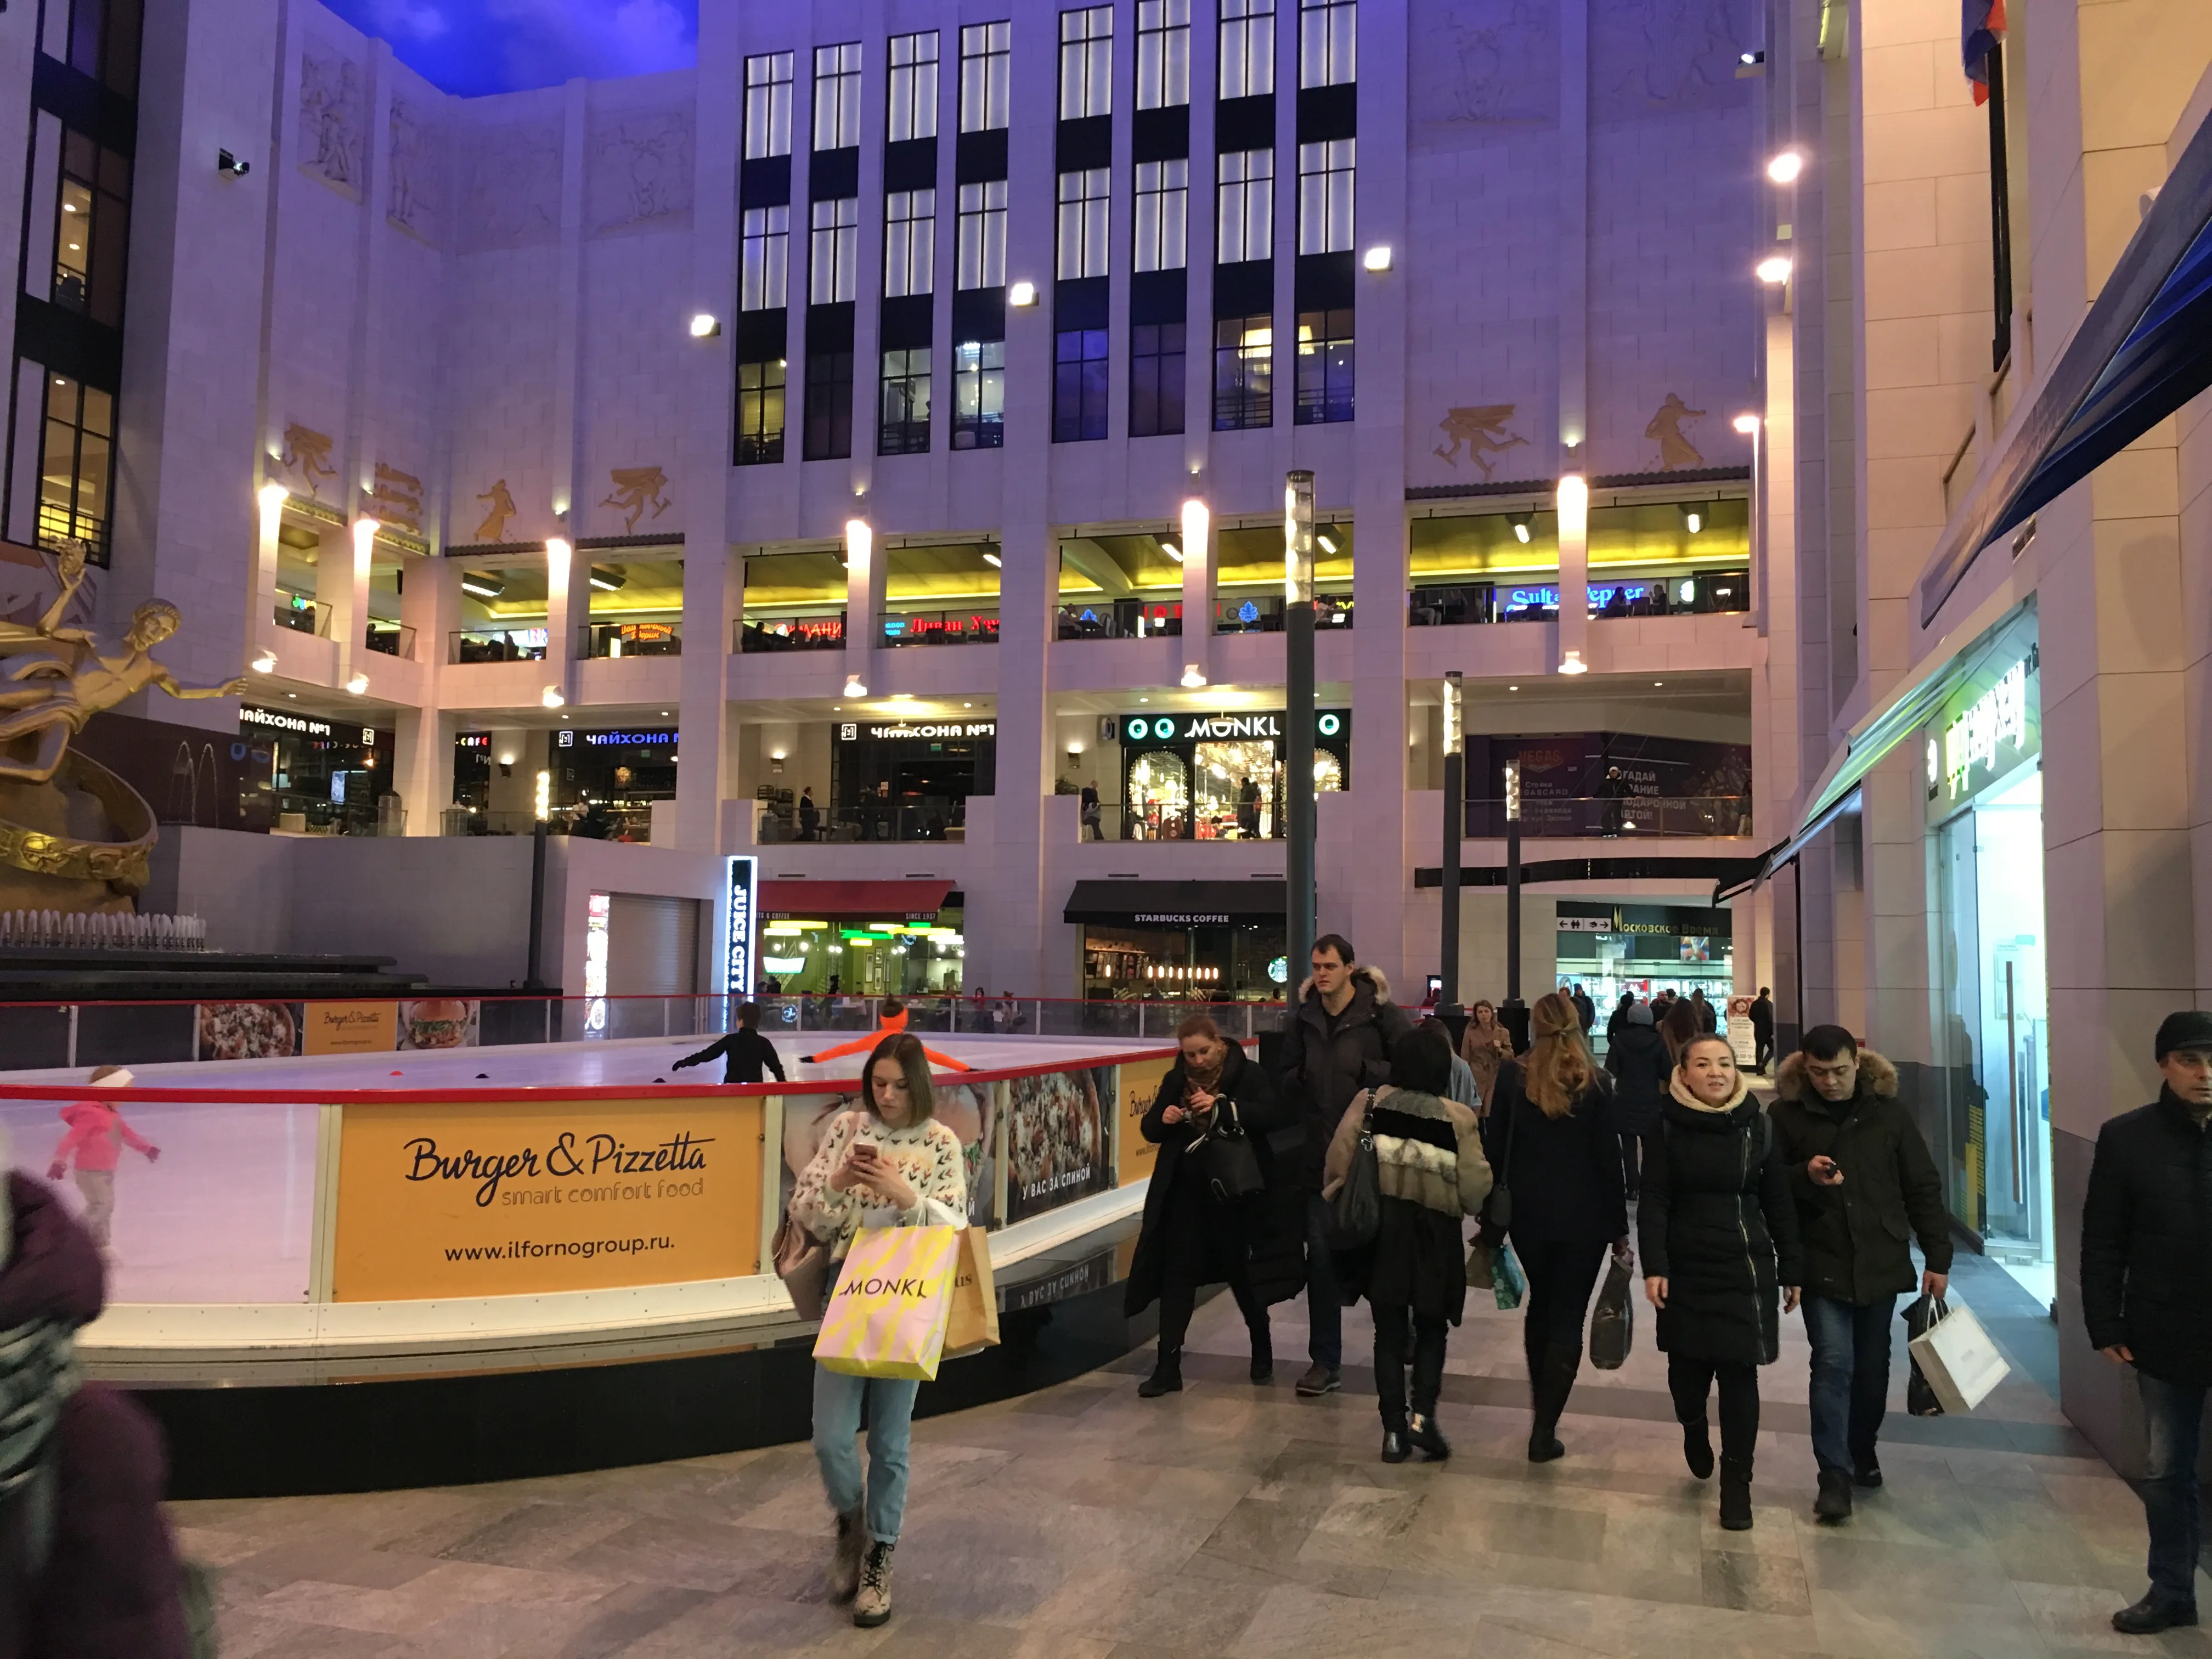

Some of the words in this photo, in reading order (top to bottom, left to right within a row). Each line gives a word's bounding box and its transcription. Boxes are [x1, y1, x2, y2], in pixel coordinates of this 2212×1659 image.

[1512, 588, 1559, 605] Sulta
[586, 731, 669, 745] ЧАЙХОНА
[1184, 716, 1281, 738] MONKI
[732, 884, 747, 943] JUICE
[1135, 914, 1191, 922] STARBUCKS
[1193, 915, 1229, 923] COFFEE
[730, 945, 746, 992] CITY
[403, 1137, 541, 1207] Burger
[546, 1132, 585, 1177] &
[586, 1131, 716, 1175] Pizzetta
[1022, 1186, 1028, 1200] У
[1030, 1180, 1047, 1198] ВАС
[1049, 1177, 1059, 1192] ЗА
[1061, 1163, 1091, 1187] СПИНОЙ
[501, 1184, 563, 1206] smart
[568, 1180, 651, 1203] comfort
[658, 1178, 704, 1198] food
[444, 1234, 675, 1262] www.ilfornogroup.ru.
[839, 1278, 928, 1299] MONKI
